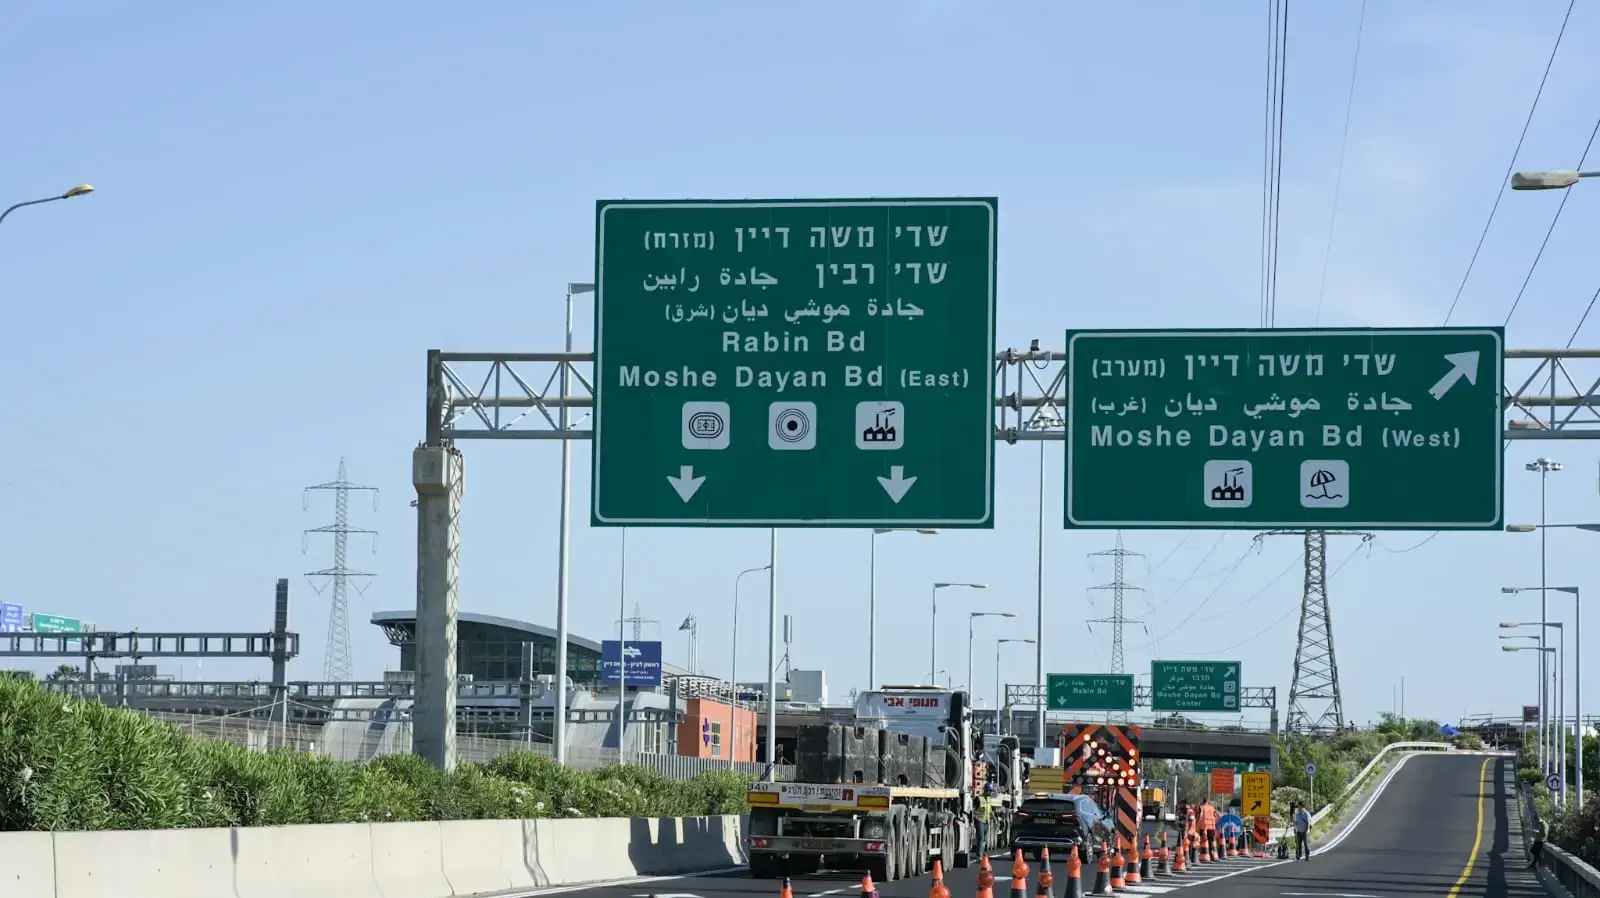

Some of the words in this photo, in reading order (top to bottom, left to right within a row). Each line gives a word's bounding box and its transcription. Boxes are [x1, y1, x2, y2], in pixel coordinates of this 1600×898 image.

[645, 232, 714, 249] (מזרח)
[735, 228, 789, 252] דיין
[811, 227, 873, 247] משה
[644, 268, 699, 292] رابين
[720, 267, 777, 289] جادة
[816, 264, 874, 288] רבין
[666, 304, 714, 322] (شرق)
[723, 300, 768, 323] ديان
[785, 300, 849, 323] موشي
[868, 298, 923, 320] جادة
[723, 332, 808, 352] Rabin
[828, 331, 864, 351] Bd
[1093, 359, 1164, 378] (מערב)
[1185, 355, 1238, 379] דיין
[1259, 355, 1322, 376] משה
[620, 366, 716, 386] Moshe
[736, 367, 825, 392] Dayan
[846, 366, 882, 386] Bd
[901, 369, 968, 387] (East)
[1092, 398, 1146, 416] (غرب)
[1165, 393, 1217, 417] ديان
[1244, 394, 1320, 418] موشي
[1348, 392, 1412, 415] جادة
[1092, 425, 1190, 446] Moshe
[1210, 425, 1303, 451] Dayan
[1323, 425, 1361, 446] Bd
[1383, 428, 1459, 448] (West)
[884, 697, 905, 707] אבי
[909, 697, 939, 707] מנופי
[1184, 691, 1208, 699] Dayan
